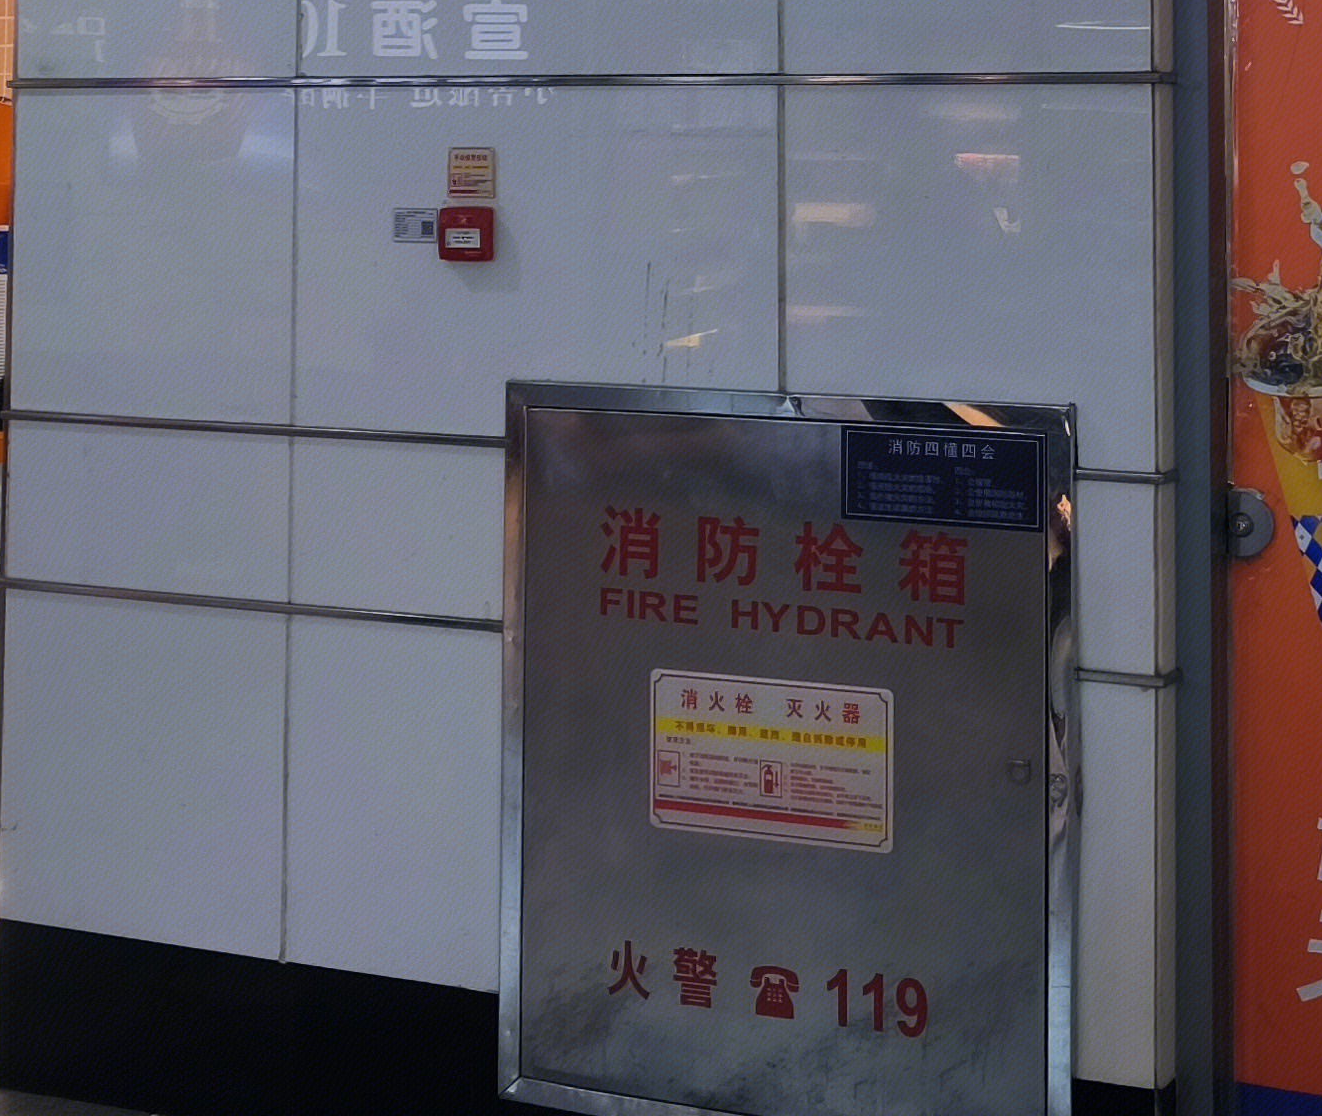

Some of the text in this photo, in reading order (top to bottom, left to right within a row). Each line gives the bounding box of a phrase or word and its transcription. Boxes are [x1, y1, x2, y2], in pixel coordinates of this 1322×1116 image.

[888, 439, 995, 460] 消防四懂四会
[599, 504, 969, 605] 消防栓箱
[599, 587, 965, 648] FIRE HYDRANT
[681, 689, 860, 724] 消火栓 灭火器
[608, 939, 928, 1038] 火警 119
